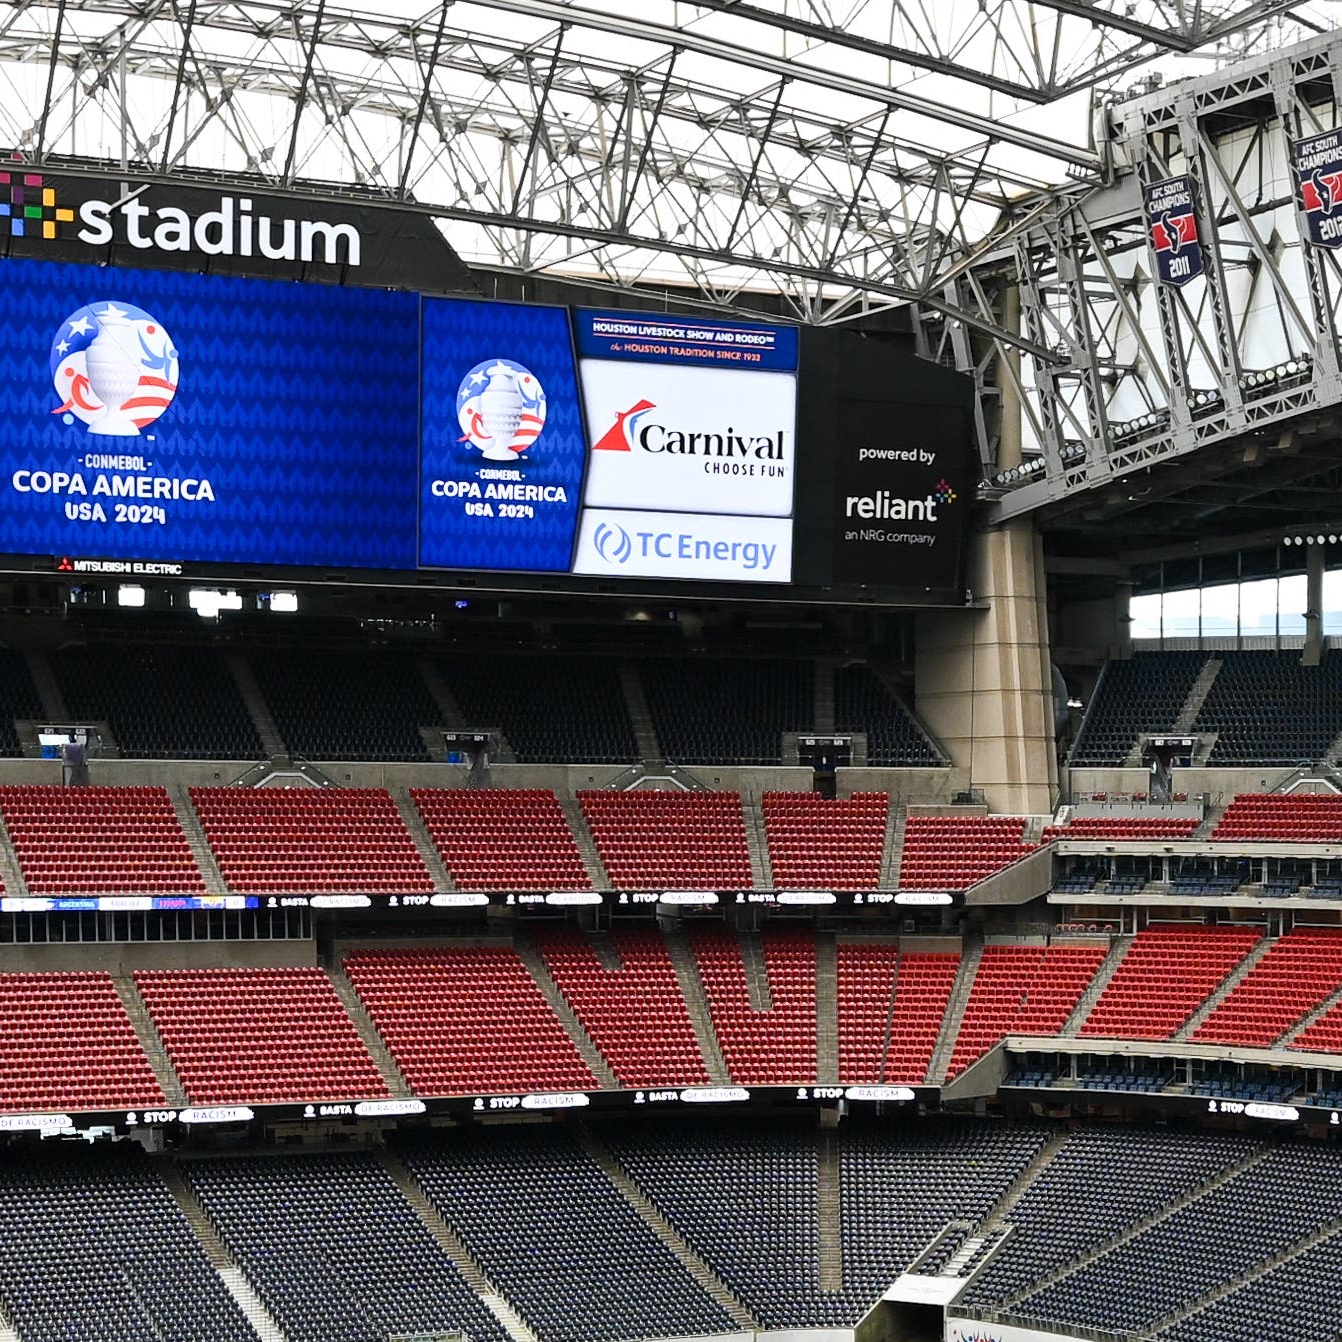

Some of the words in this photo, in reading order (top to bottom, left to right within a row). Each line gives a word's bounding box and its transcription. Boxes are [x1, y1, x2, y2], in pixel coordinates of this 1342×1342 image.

[1302, 141, 1314, 156] AFC
[1315, 134, 1338, 152] SOUTH
[1151, 186, 1164, 200] AFC
[1164, 181, 1185, 196] SOUTH
[1149, 191, 1191, 214] CHAMPIONS
[77, 196, 361, 267] stadium
[1168, 255, 1191, 279] 2011
[593, 322, 638, 335] HOUSTON
[638, 325, 686, 340] LIVESTOCK
[686, 328, 715, 341] SHOW
[715, 331, 736, 343] AND
[624, 343, 668, 355] HOUSTON
[669, 346, 715, 359] TRADITION
[716, 350, 742, 361] SINCE
[640, 424, 785, 461] Carnival
[859, 448, 917, 462] powered
[919, 448, 936, 466] by
[704, 461, 756, 476] CHOOSE
[760, 464, 786, 478] FUN
[12, 470, 87, 495] COPA
[92, 474, 216, 502] AMERICA
[431, 480, 483, 499] COPA
[484, 483, 568, 503] AMERICA
[65, 501, 107, 522] USA
[114, 503, 167, 525] 2024
[465, 502, 495, 518] USA
[498, 503, 535, 519] 2024
[846, 490, 938, 522] reliant
[844, 530, 859, 542] an
[859, 529, 886, 542] NRG
[887, 532, 936, 548] company
[637, 532, 673, 558] TC
[678, 533, 777, 570] Energy
[73, 560, 132, 574] MITSUBISHI
[133, 563, 183, 576] ELECTRIC
[0, 1116, 15, 1129] DE
[19, 1116, 68, 1129] RACISMO
[144, 1111, 178, 1124] STOP
[192, 1109, 238, 1121] RACISM
